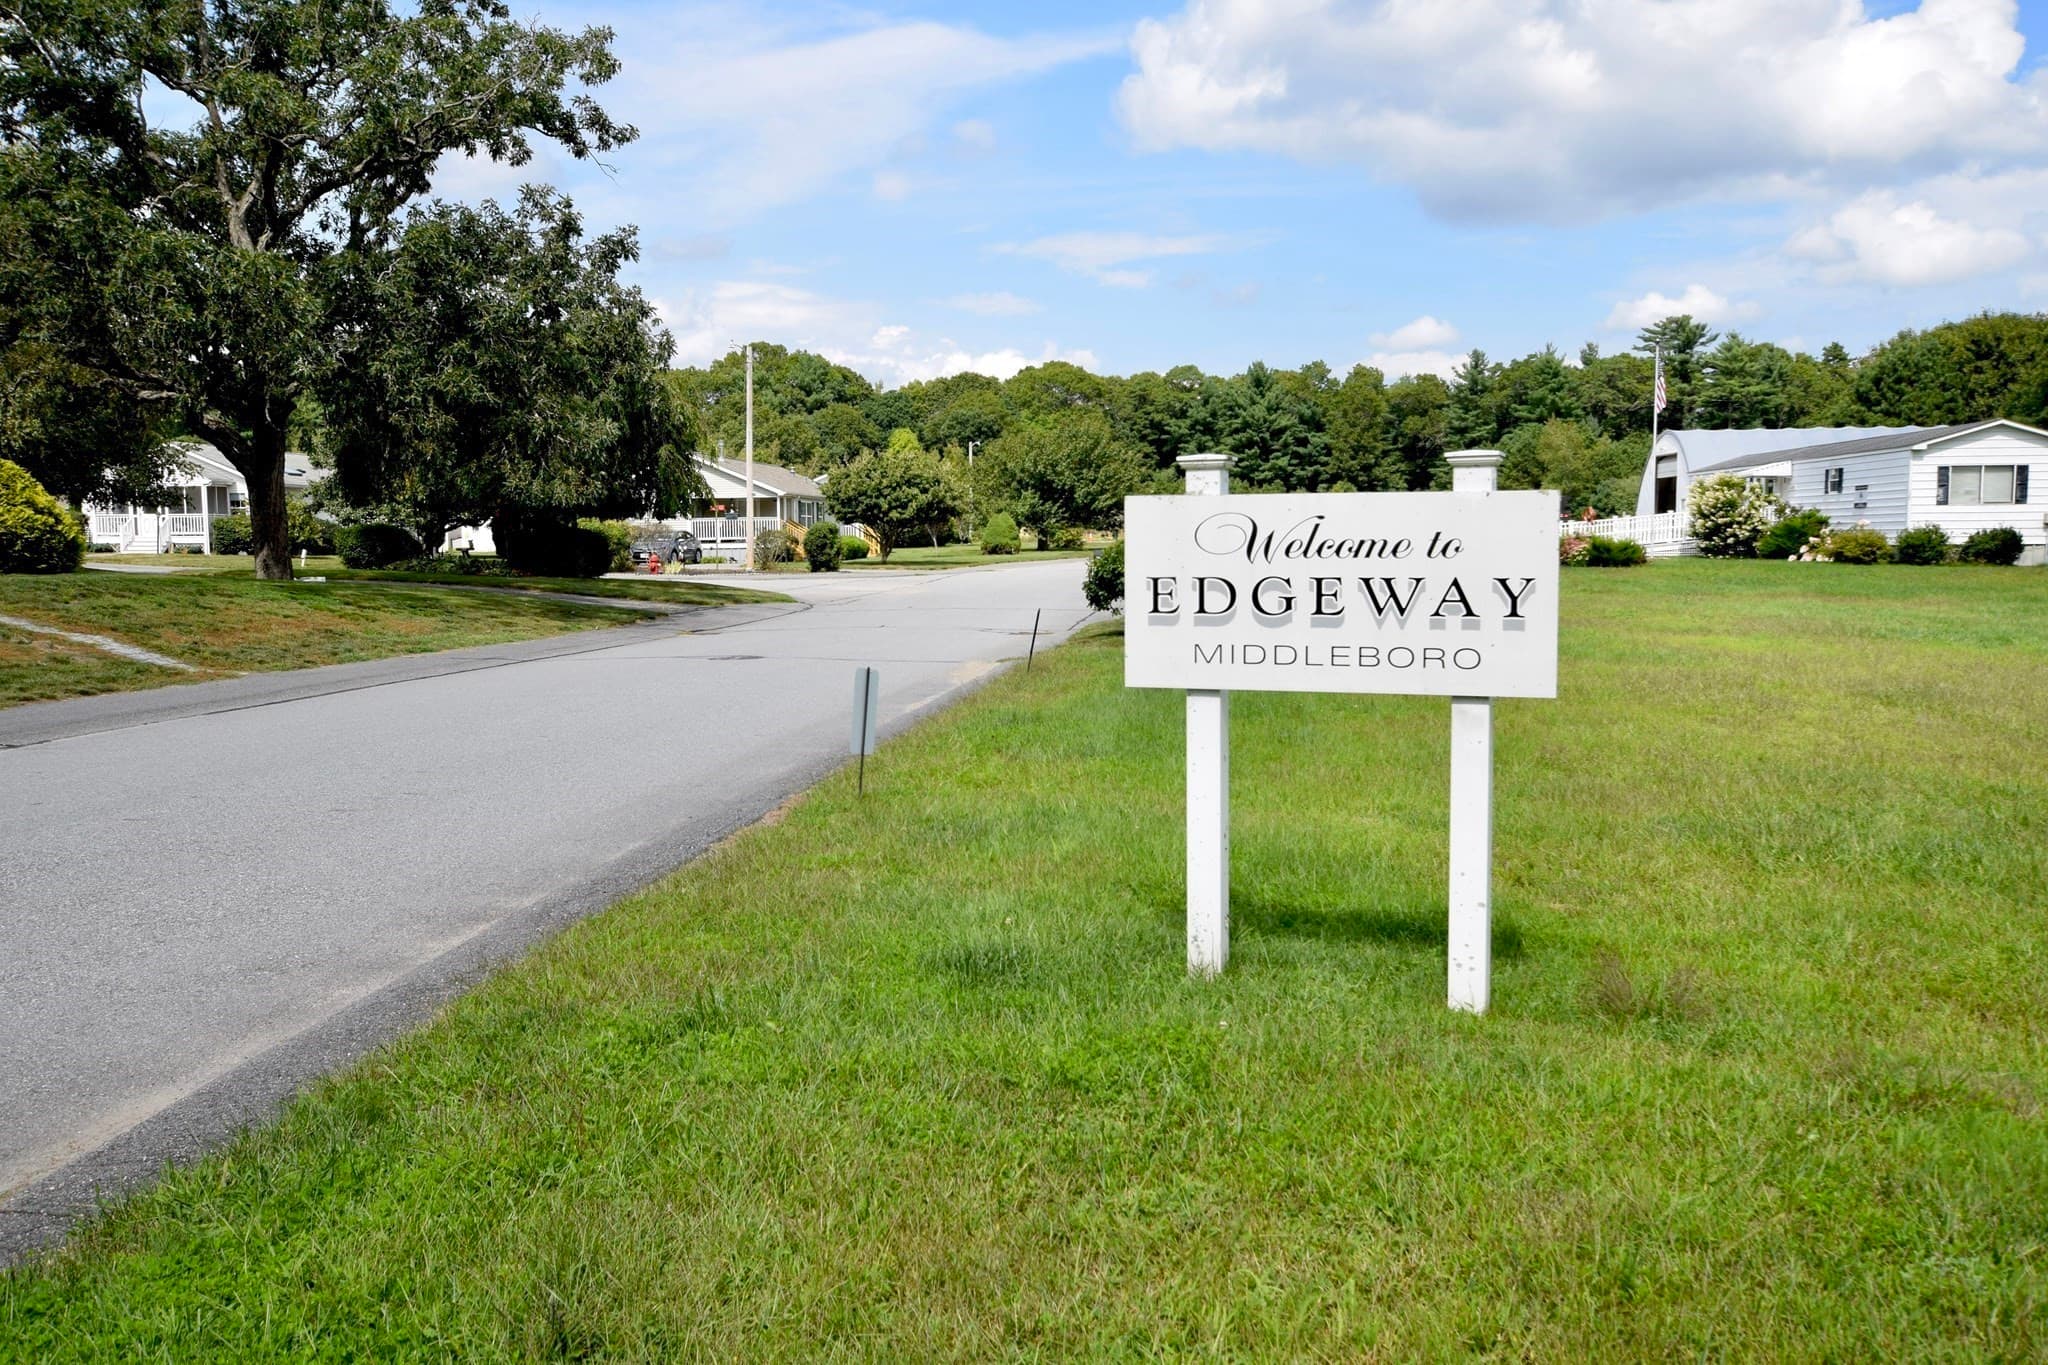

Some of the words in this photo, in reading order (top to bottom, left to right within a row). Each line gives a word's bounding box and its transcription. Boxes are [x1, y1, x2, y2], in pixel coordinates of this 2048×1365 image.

[1194, 512, 1414, 564] Welcome
[1426, 531, 1465, 559] to
[1146, 575, 1537, 621] EDGEWAY
[1194, 643, 1482, 670] MIDDLEBORO
